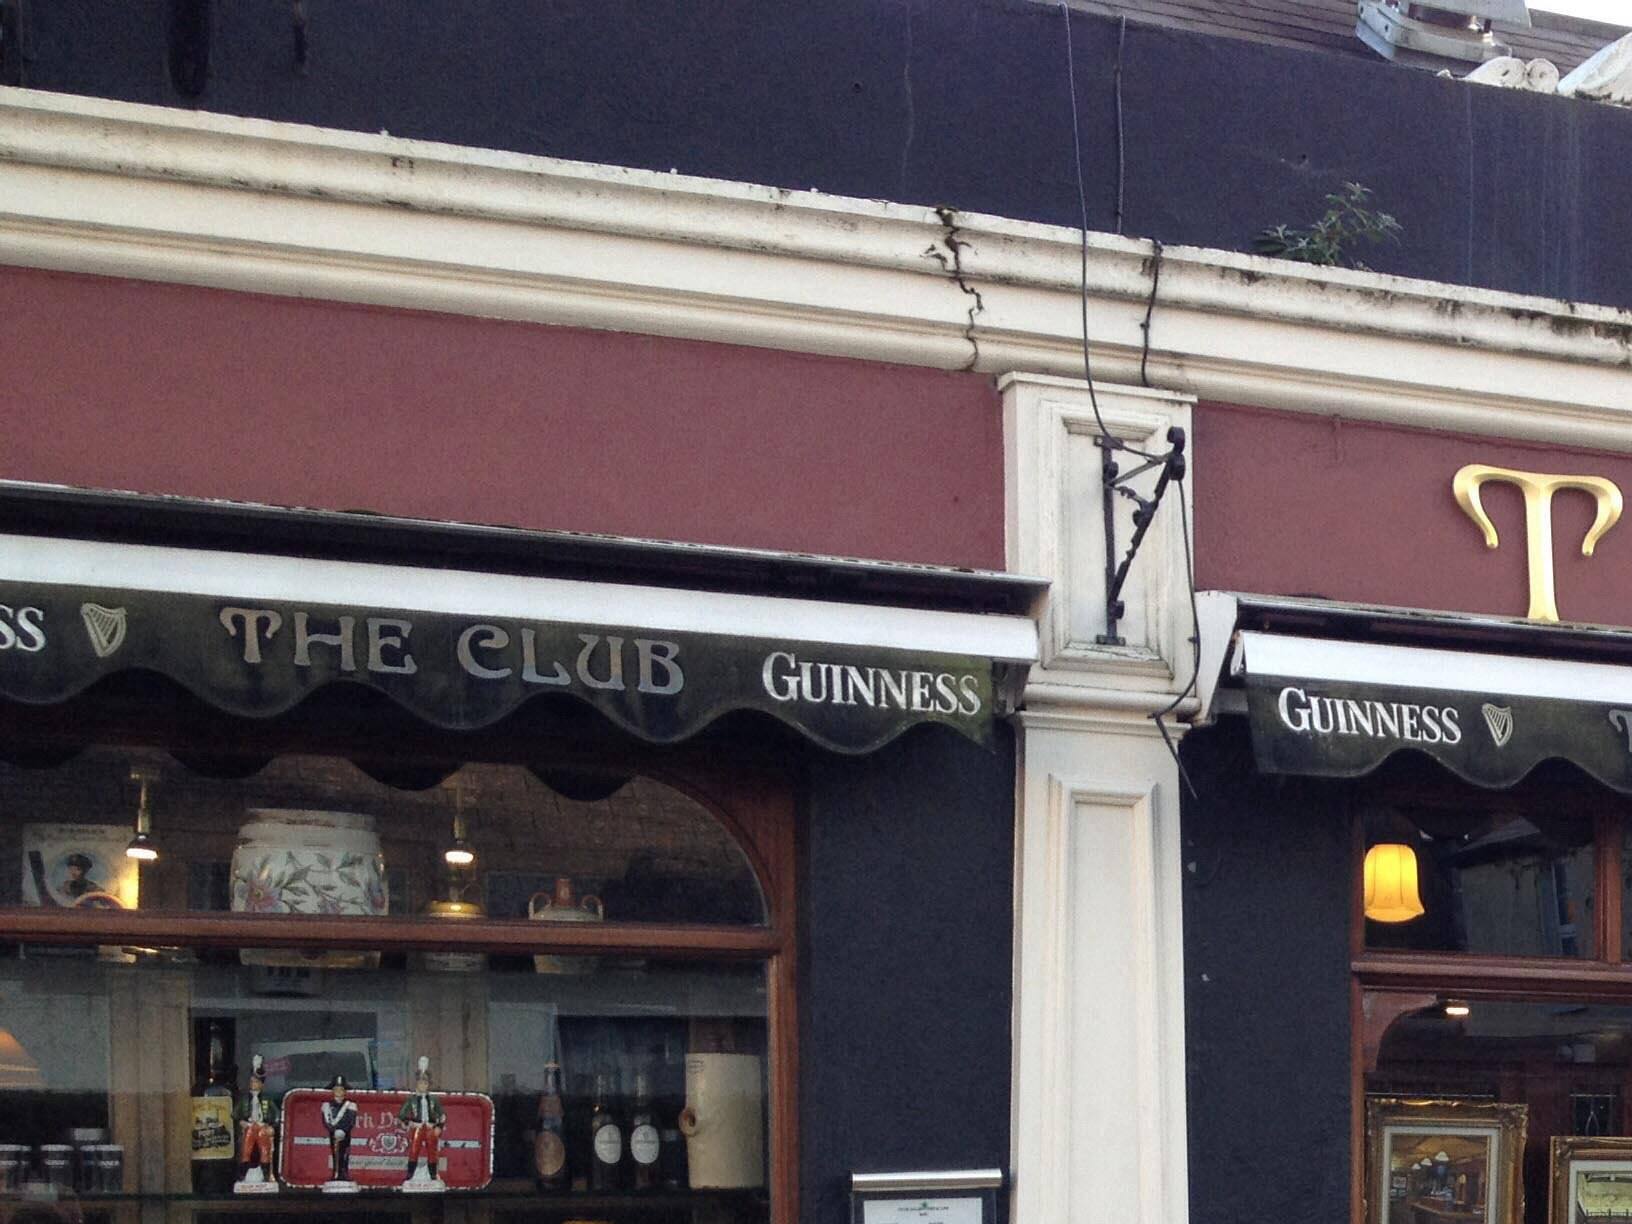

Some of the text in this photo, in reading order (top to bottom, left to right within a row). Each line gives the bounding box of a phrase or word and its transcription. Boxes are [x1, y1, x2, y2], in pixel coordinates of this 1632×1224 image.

[219, 606, 684, 696] THE CLUB
[761, 652, 982, 717] GUINNESS
[1278, 687, 1462, 745] GUINNESS
